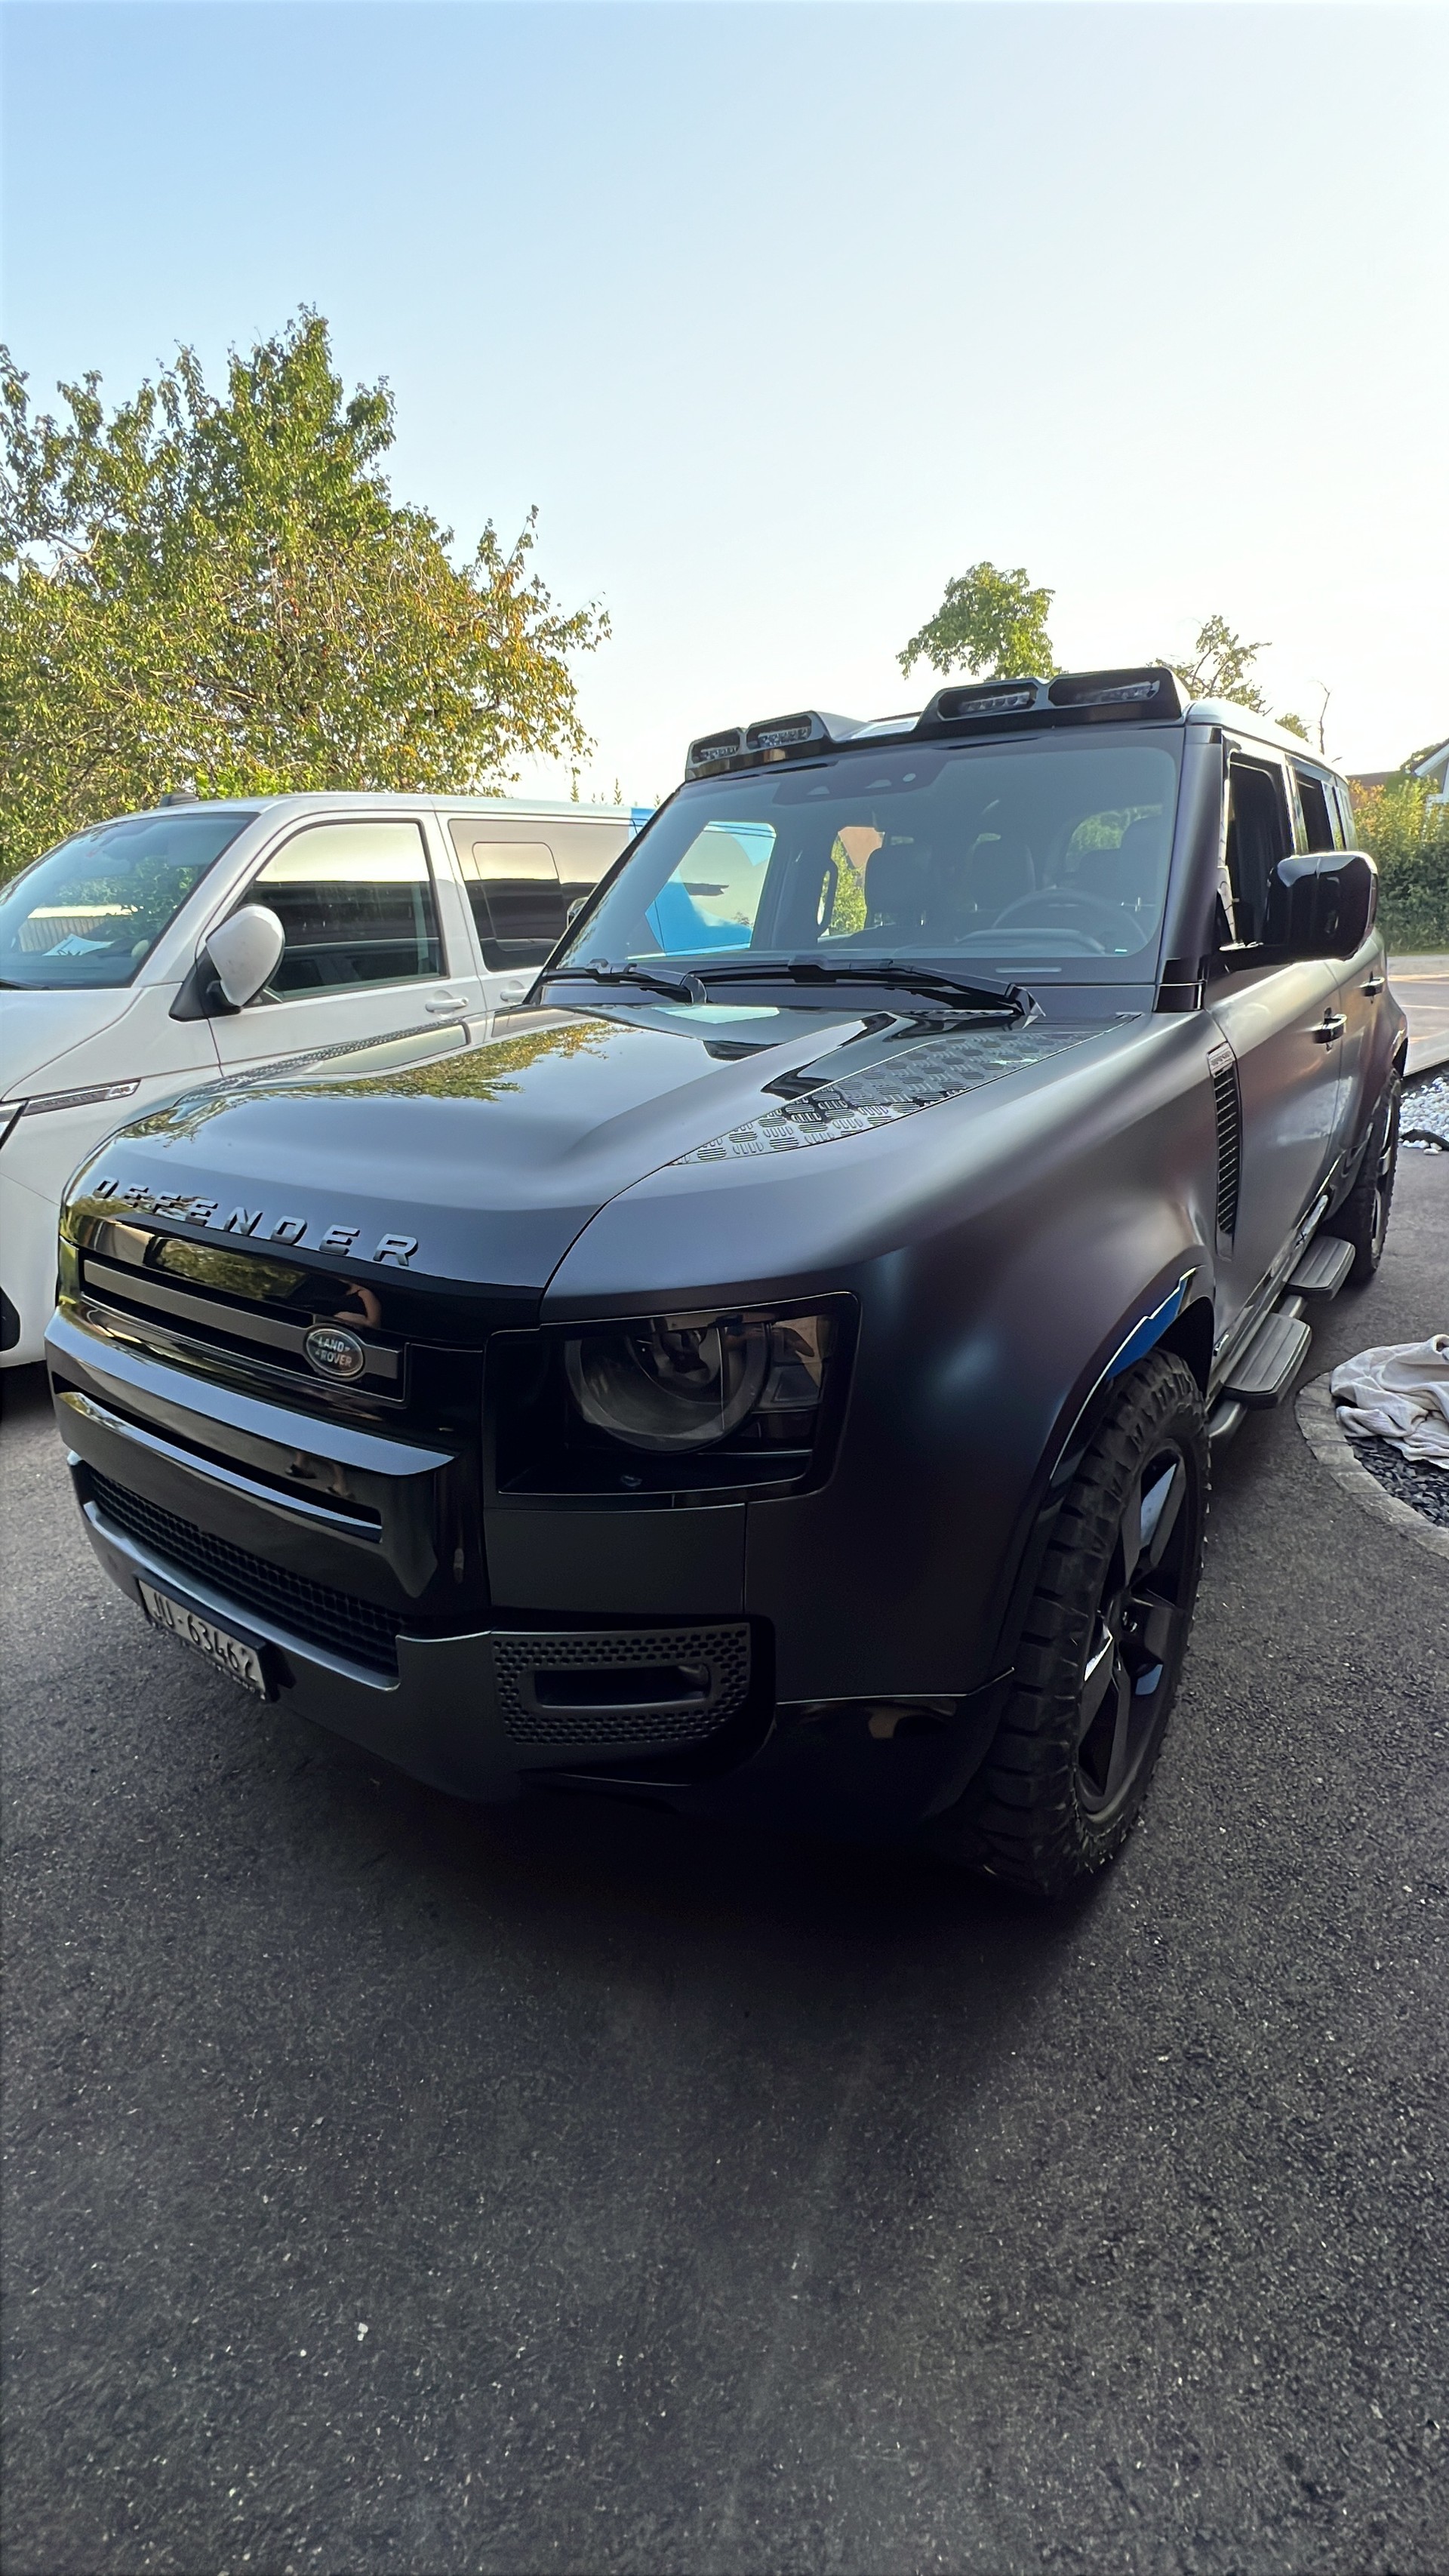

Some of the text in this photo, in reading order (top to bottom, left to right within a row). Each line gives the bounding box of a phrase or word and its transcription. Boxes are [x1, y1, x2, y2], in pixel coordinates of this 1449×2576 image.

[93, 1177, 419, 1266] DEFENDER
[318, 1337, 345, 1352] LAND
[320, 1351, 352, 1367] ROVER
